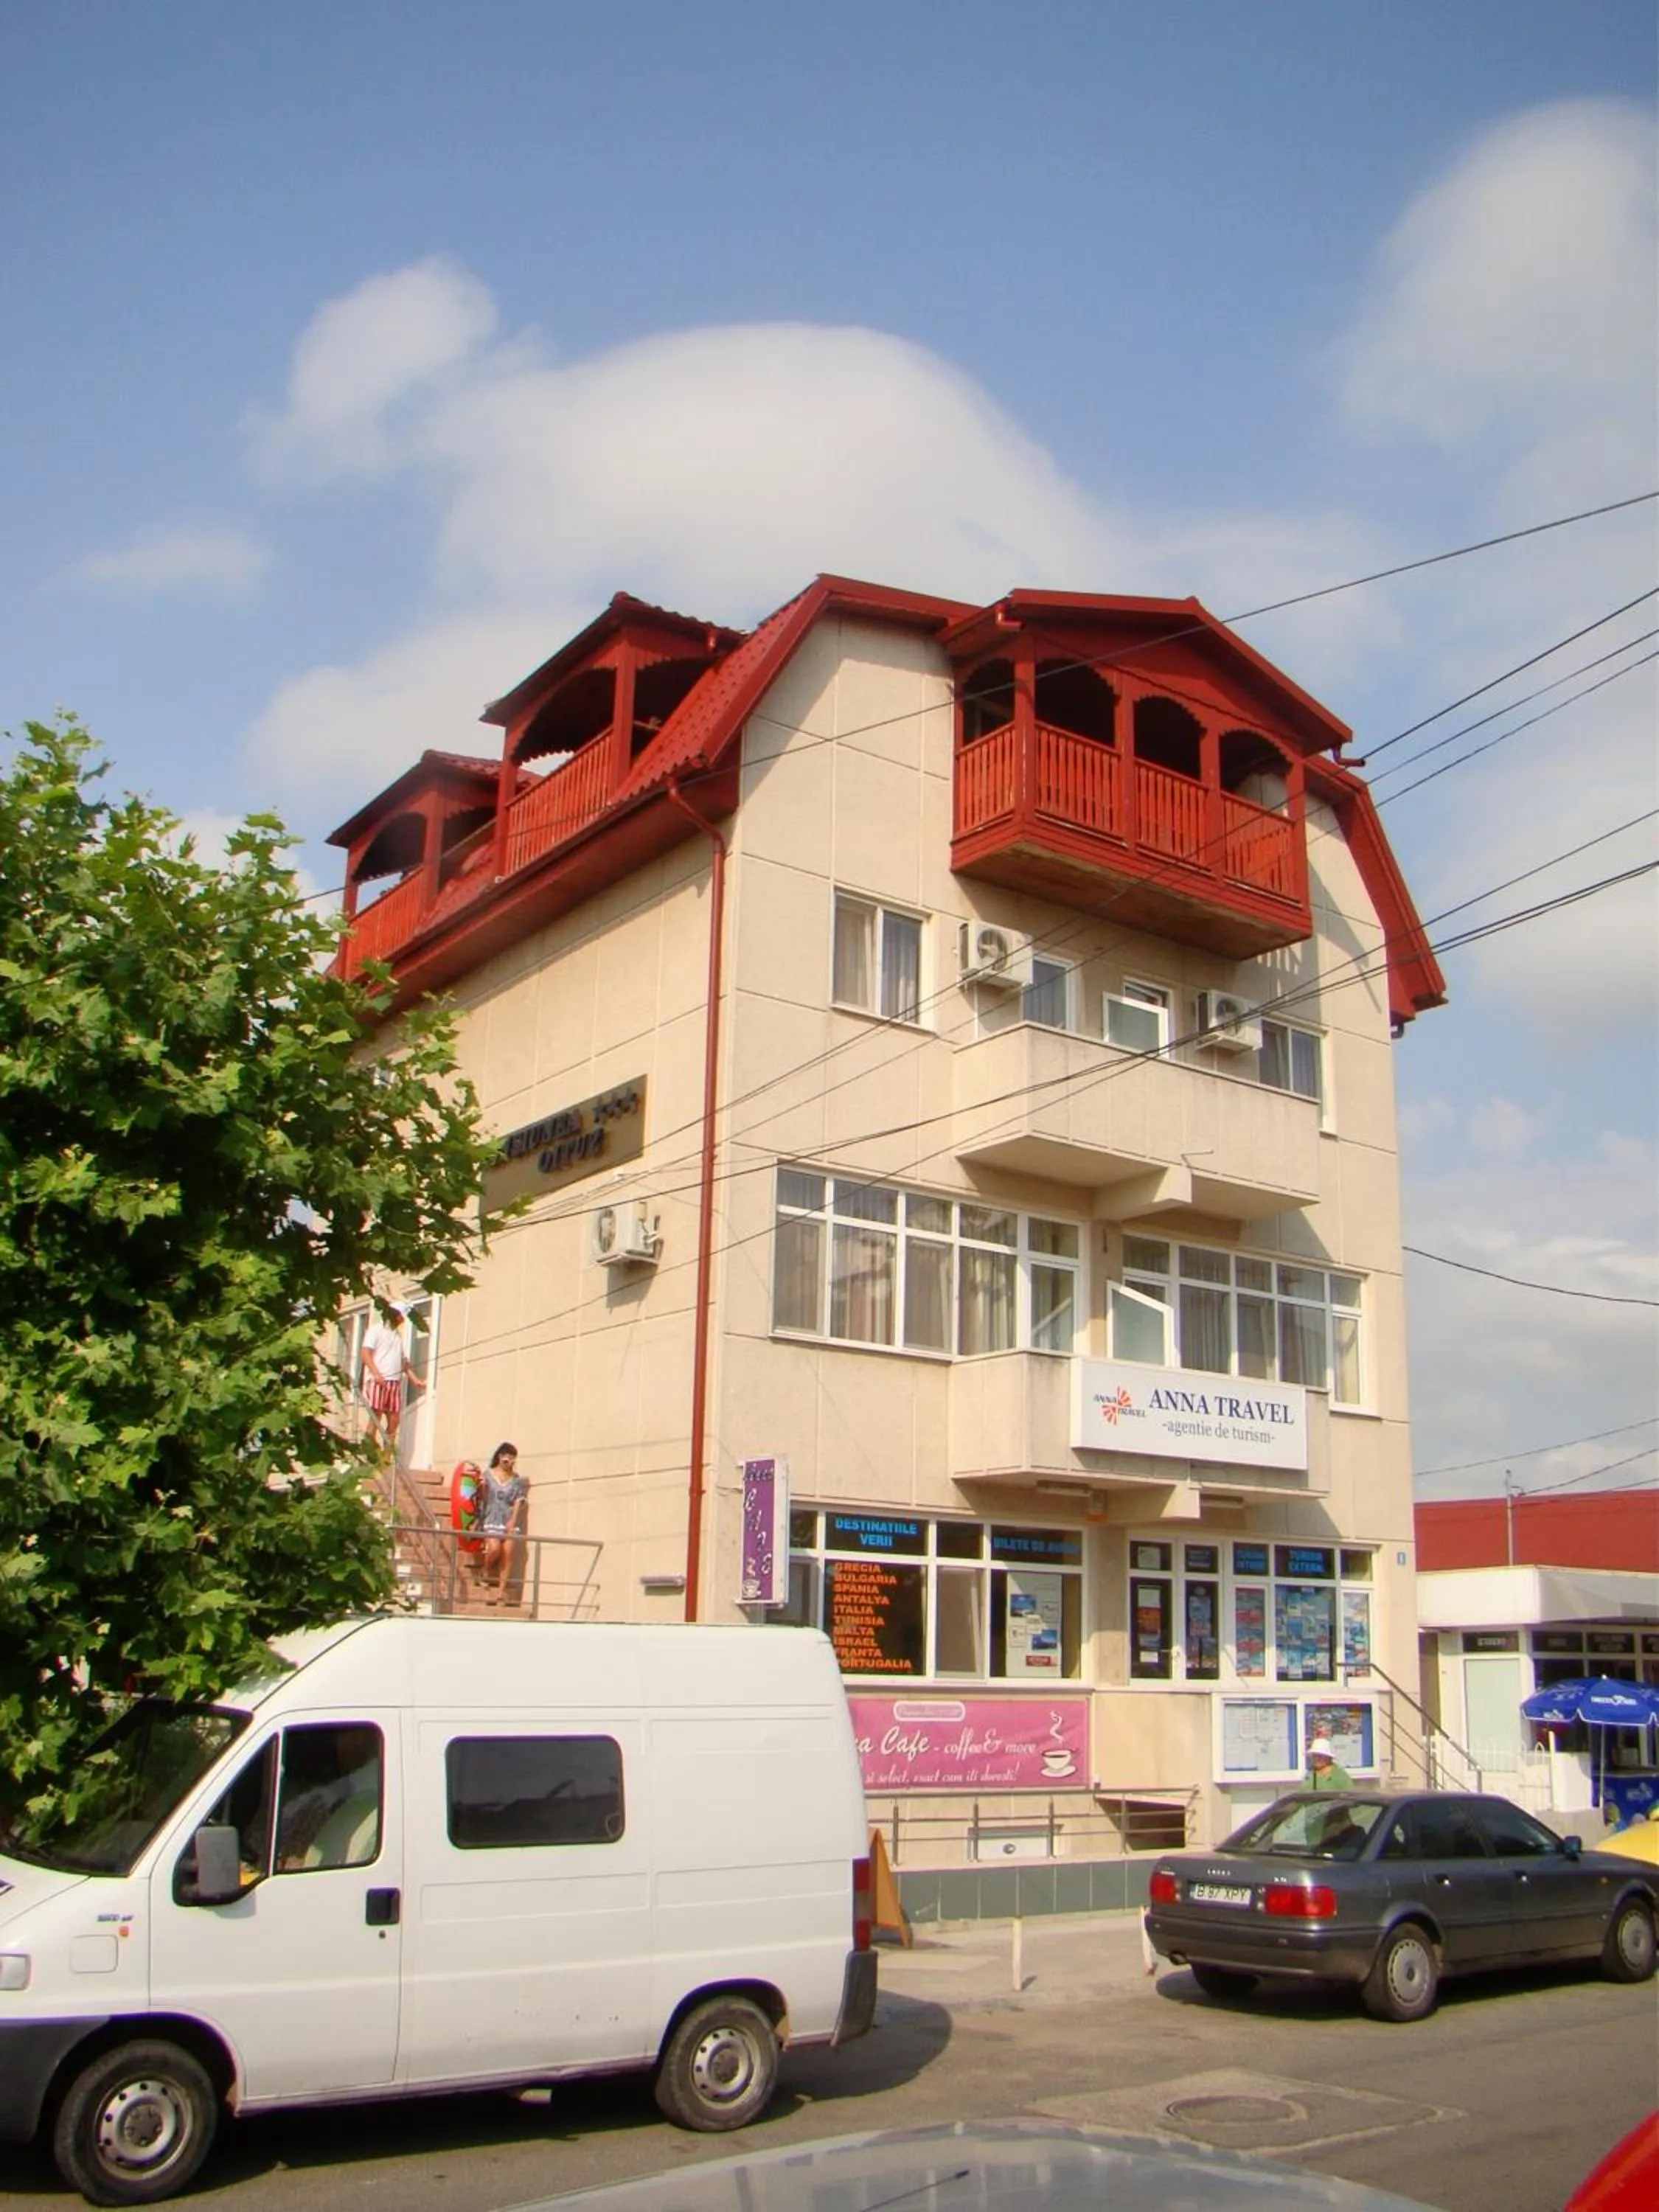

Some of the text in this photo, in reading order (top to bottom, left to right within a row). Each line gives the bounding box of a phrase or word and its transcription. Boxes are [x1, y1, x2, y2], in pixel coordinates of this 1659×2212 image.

[1149, 1388, 1295, 1425] ANNA TRAVEL
[1214, 1422, 1230, 1439] de
[835, 1517, 918, 1534] DESTINATIILE
[860, 1533, 893, 1547] VERII
[834, 1562, 881, 1573] GRECIA
[833, 1572, 897, 1584] BULGARIA
[833, 1583, 880, 1594] SPANIA
[833, 1594, 890, 1605] ANTALYA
[833, 1604, 874, 1615] ITALIA
[833, 1615, 885, 1626] TUNISIA
[833, 1626, 875, 1636] MALTA
[833, 1636, 878, 1647] ISRAEL
[838, 1658, 913, 1669] ORTUGALIA
[880, 1725, 930, 1761] Cafe
[1005, 1742, 1037, 1754] more
[942, 1773, 963, 1783] cum
[1197, 1883, 1205, 1897] B
